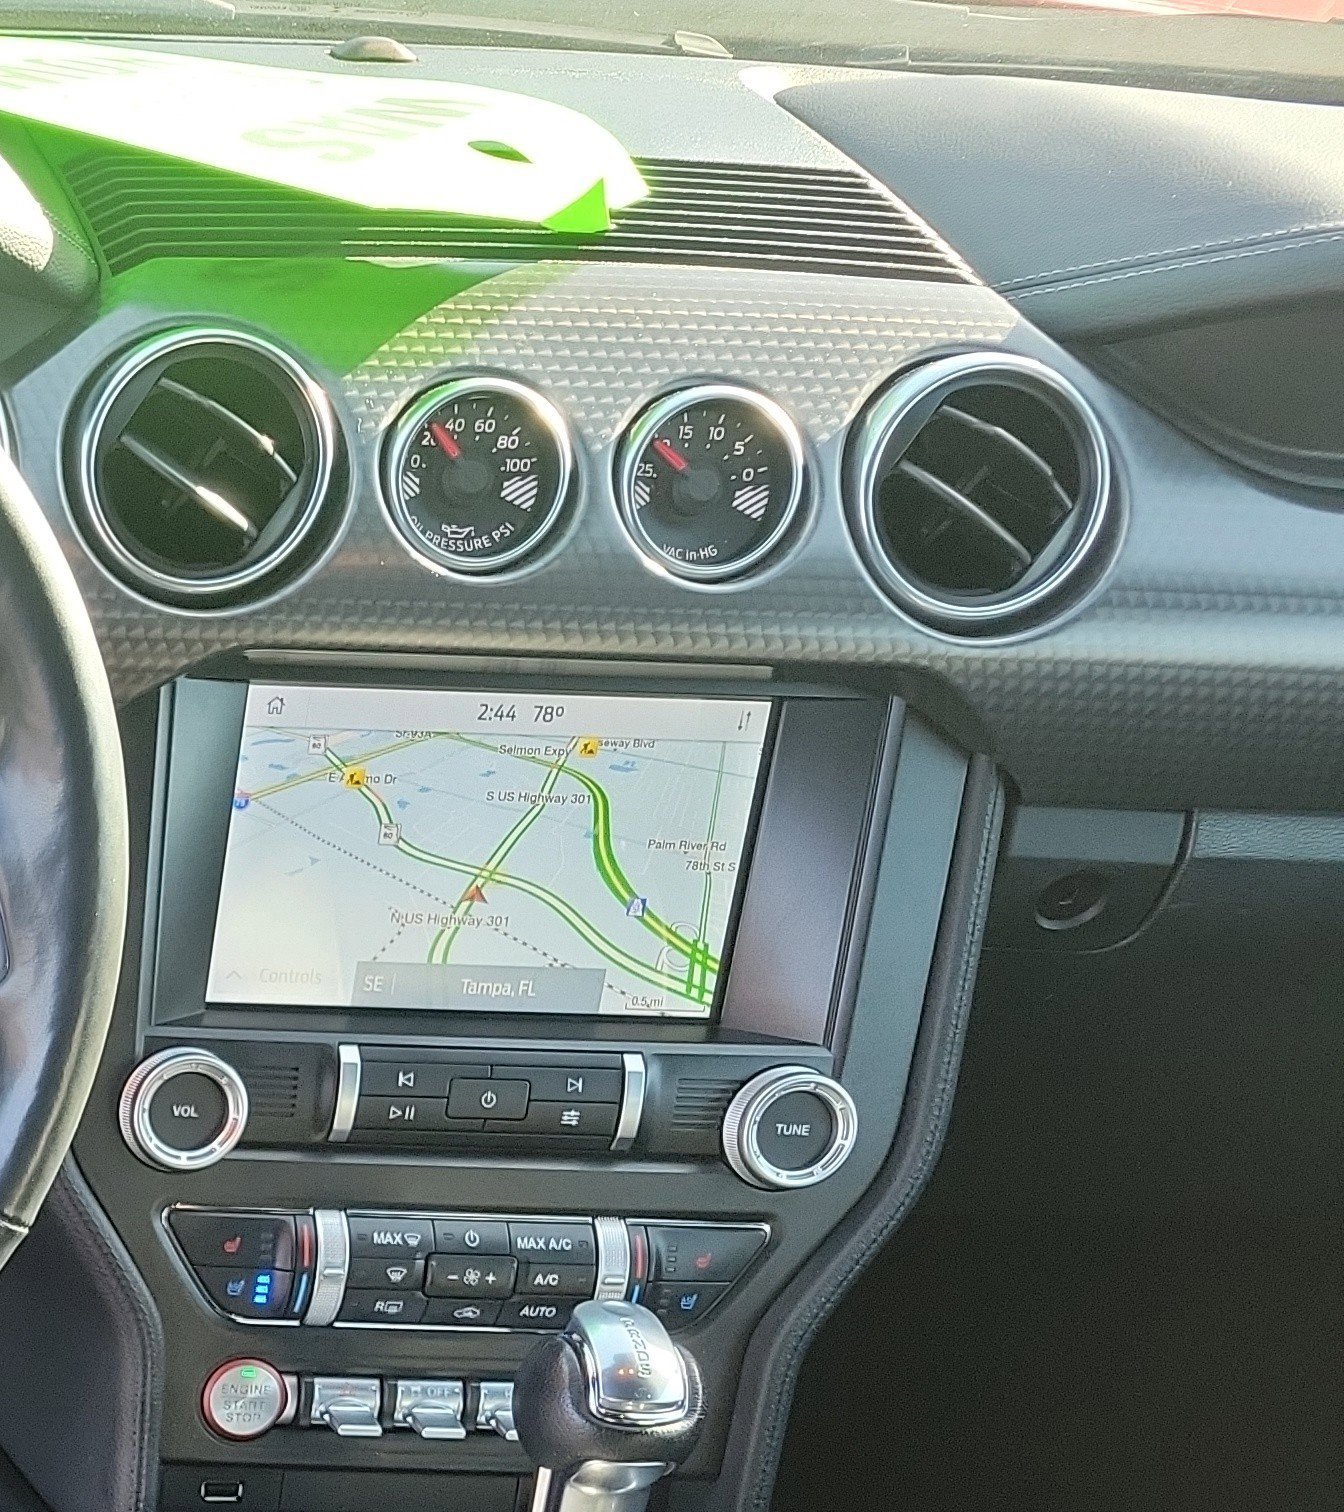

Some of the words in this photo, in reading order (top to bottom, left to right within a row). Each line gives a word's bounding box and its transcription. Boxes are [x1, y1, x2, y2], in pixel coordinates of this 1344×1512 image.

[445, 418, 465, 433] 40
[474, 419, 496, 433] 60
[678, 425, 693, 439] 15
[709, 426, 725, 441] 10
[496, 435, 519, 450] 80
[733, 441, 745, 456] 5
[410, 454, 421, 468] 0
[504, 458, 531, 472] 100
[637, 463, 654, 477] 25
[742, 468, 754, 482] 0
[425, 529, 492, 552] PRESSURE
[491, 521, 515, 543] PSI
[662, 543, 684, 560] VAC
[477, 703, 517, 722] 2:44
[499, 744, 541, 756] Selmon
[632, 739, 655, 750] Blvd
[384, 774, 397, 784] Dr
[486, 791, 495, 802] S
[498, 791, 515, 802] US
[518, 792, 568, 806] Highway
[571, 794, 591, 805] 301
[648, 839, 676, 851] Palm
[679, 840, 707, 852] River
[711, 841, 727, 852] Rd
[686, 860, 709, 872] 78th
[713, 861, 726, 872] St
[728, 862, 737, 872] S
[391, 911, 402, 924] N
[405, 912, 423, 925] US
[426, 913, 483, 929] Highway
[486, 915, 510, 928] 301
[363, 976, 383, 992] SE
[462, 978, 516, 998] Tampa,
[519, 981, 536, 996] FL
[631, 996, 647, 1006] 0.5
[173, 1104, 199, 1118] VOL
[775, 1123, 810, 1137] TUNE
[372, 1231, 403, 1246] MAX
[516, 1235, 545, 1250] MAX
[548, 1237, 573, 1251] A/C
[534, 1272, 558, 1286] A/C
[519, 1304, 557, 1318] AUTO
[221, 1383, 271, 1396] ENGINE
[427, 1386, 451, 1398] OFF
[223, 1400, 266, 1411] START
[225, 1412, 262, 1423] STOP
